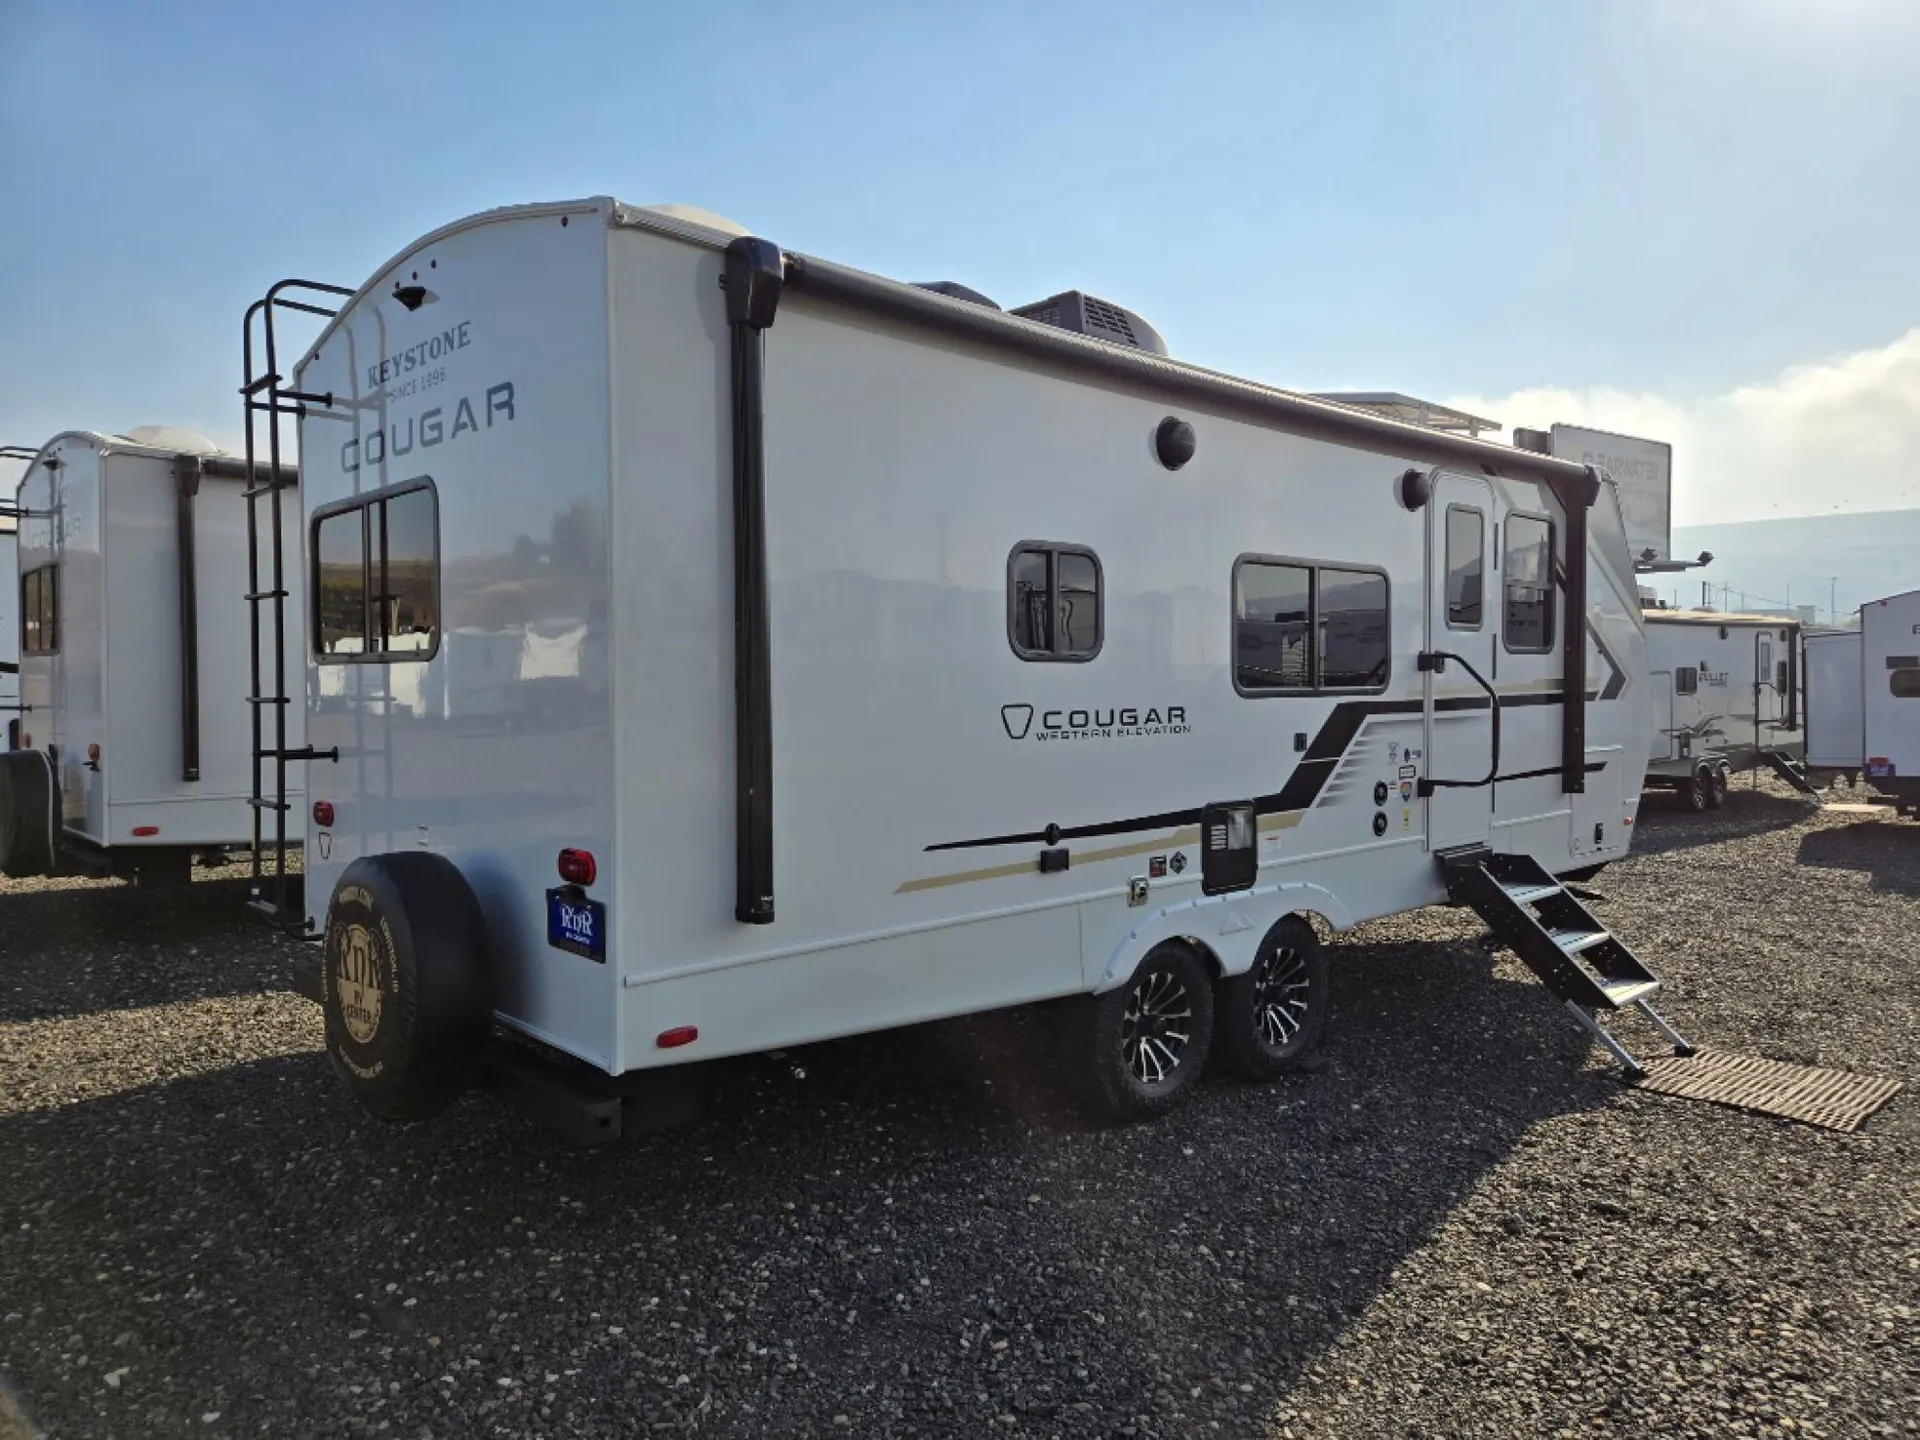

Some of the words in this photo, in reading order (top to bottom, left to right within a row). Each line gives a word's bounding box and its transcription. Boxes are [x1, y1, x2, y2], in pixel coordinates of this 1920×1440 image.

[367, 320, 472, 389] KEYSTONE
[341, 381, 515, 473] COUGAR
[1035, 729, 1111, 741] WESTERN
[1117, 725, 1191, 737] ELEVATION
[1043, 706, 1186, 730] COUGAR
